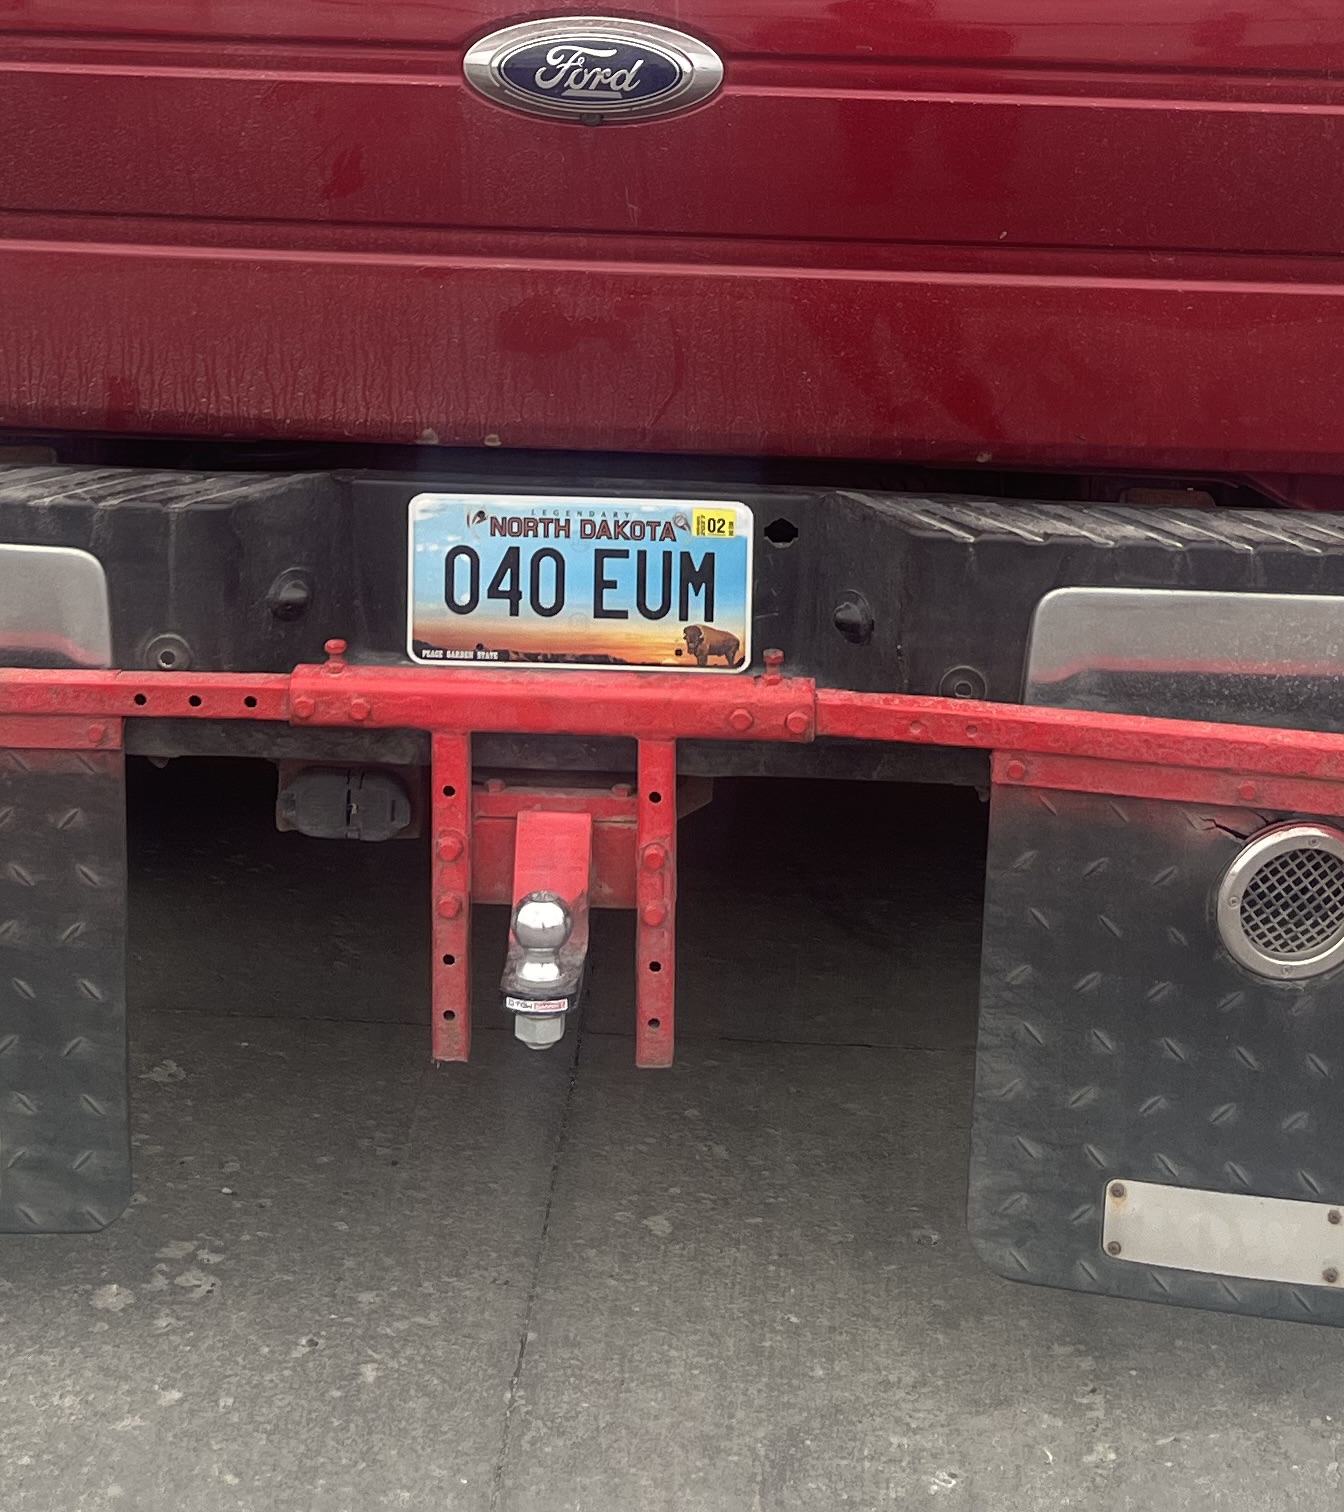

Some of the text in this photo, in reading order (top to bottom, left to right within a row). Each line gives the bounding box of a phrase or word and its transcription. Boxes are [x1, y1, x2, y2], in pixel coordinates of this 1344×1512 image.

[534, 44, 645, 92] Ford
[531, 509, 630, 518] LEGENDARY
[707, 518, 726, 533] 02
[490, 516, 571, 539] NORTH
[579, 519, 677, 542] DAKOTA
[444, 545, 716, 622] 040 EUM
